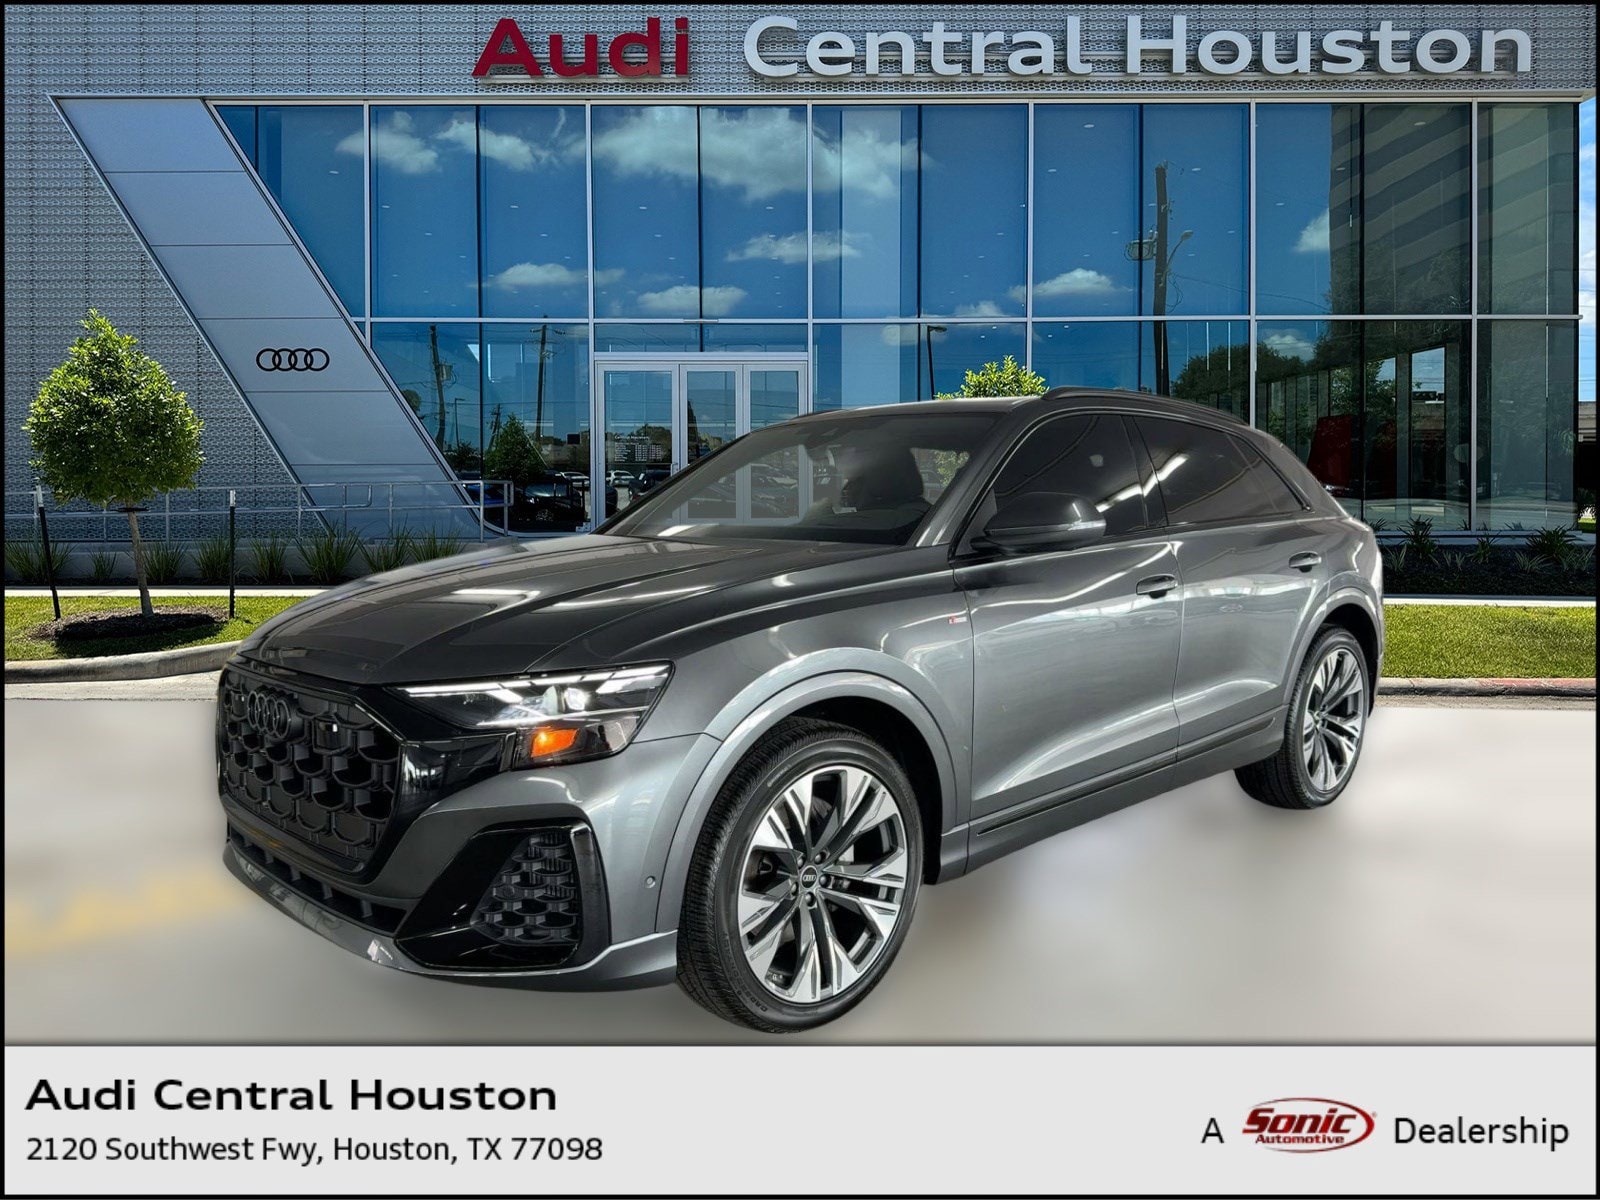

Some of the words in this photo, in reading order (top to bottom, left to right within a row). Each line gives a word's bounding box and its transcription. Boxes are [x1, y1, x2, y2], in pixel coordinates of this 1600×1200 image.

[471, 17, 689, 78] Audi
[743, 15, 1093, 77] Central
[1126, 15, 1532, 74] Houston
